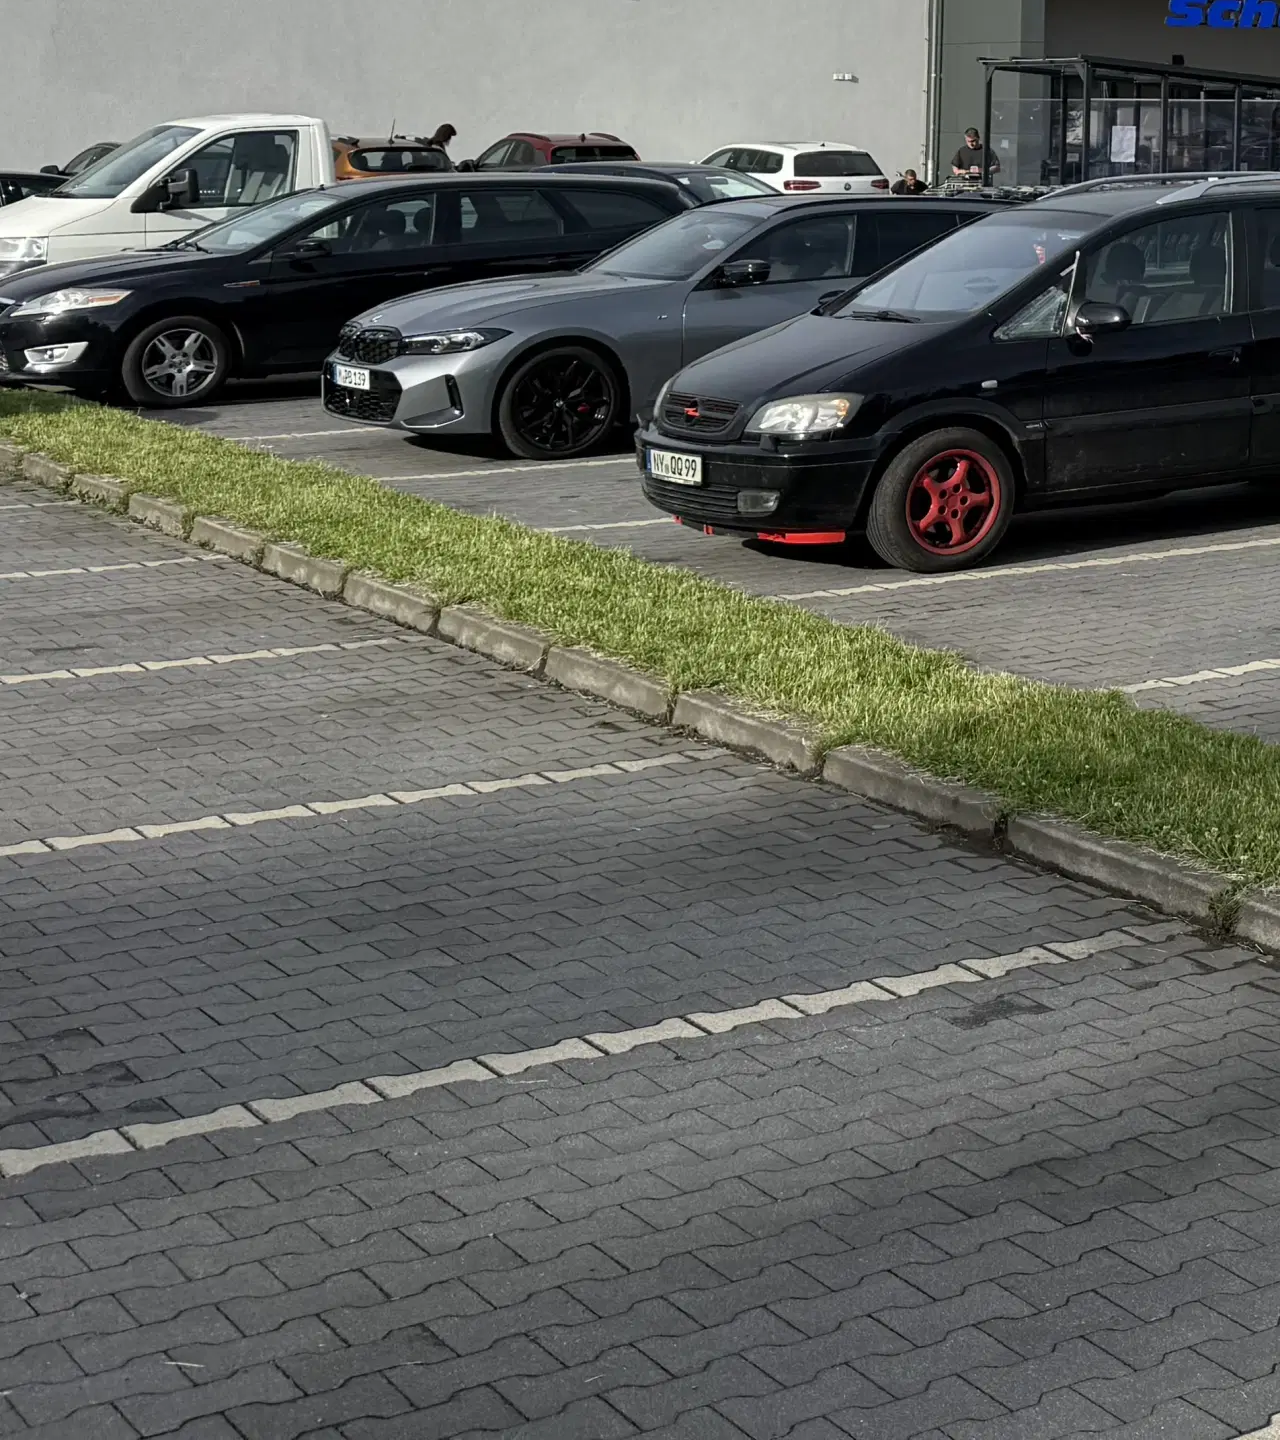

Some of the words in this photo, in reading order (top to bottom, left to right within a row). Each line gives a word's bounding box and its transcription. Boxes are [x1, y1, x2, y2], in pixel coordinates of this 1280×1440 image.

[653, 452, 664, 472] NY
[671, 455, 683, 476] QQ
[685, 458, 697, 478] 99
